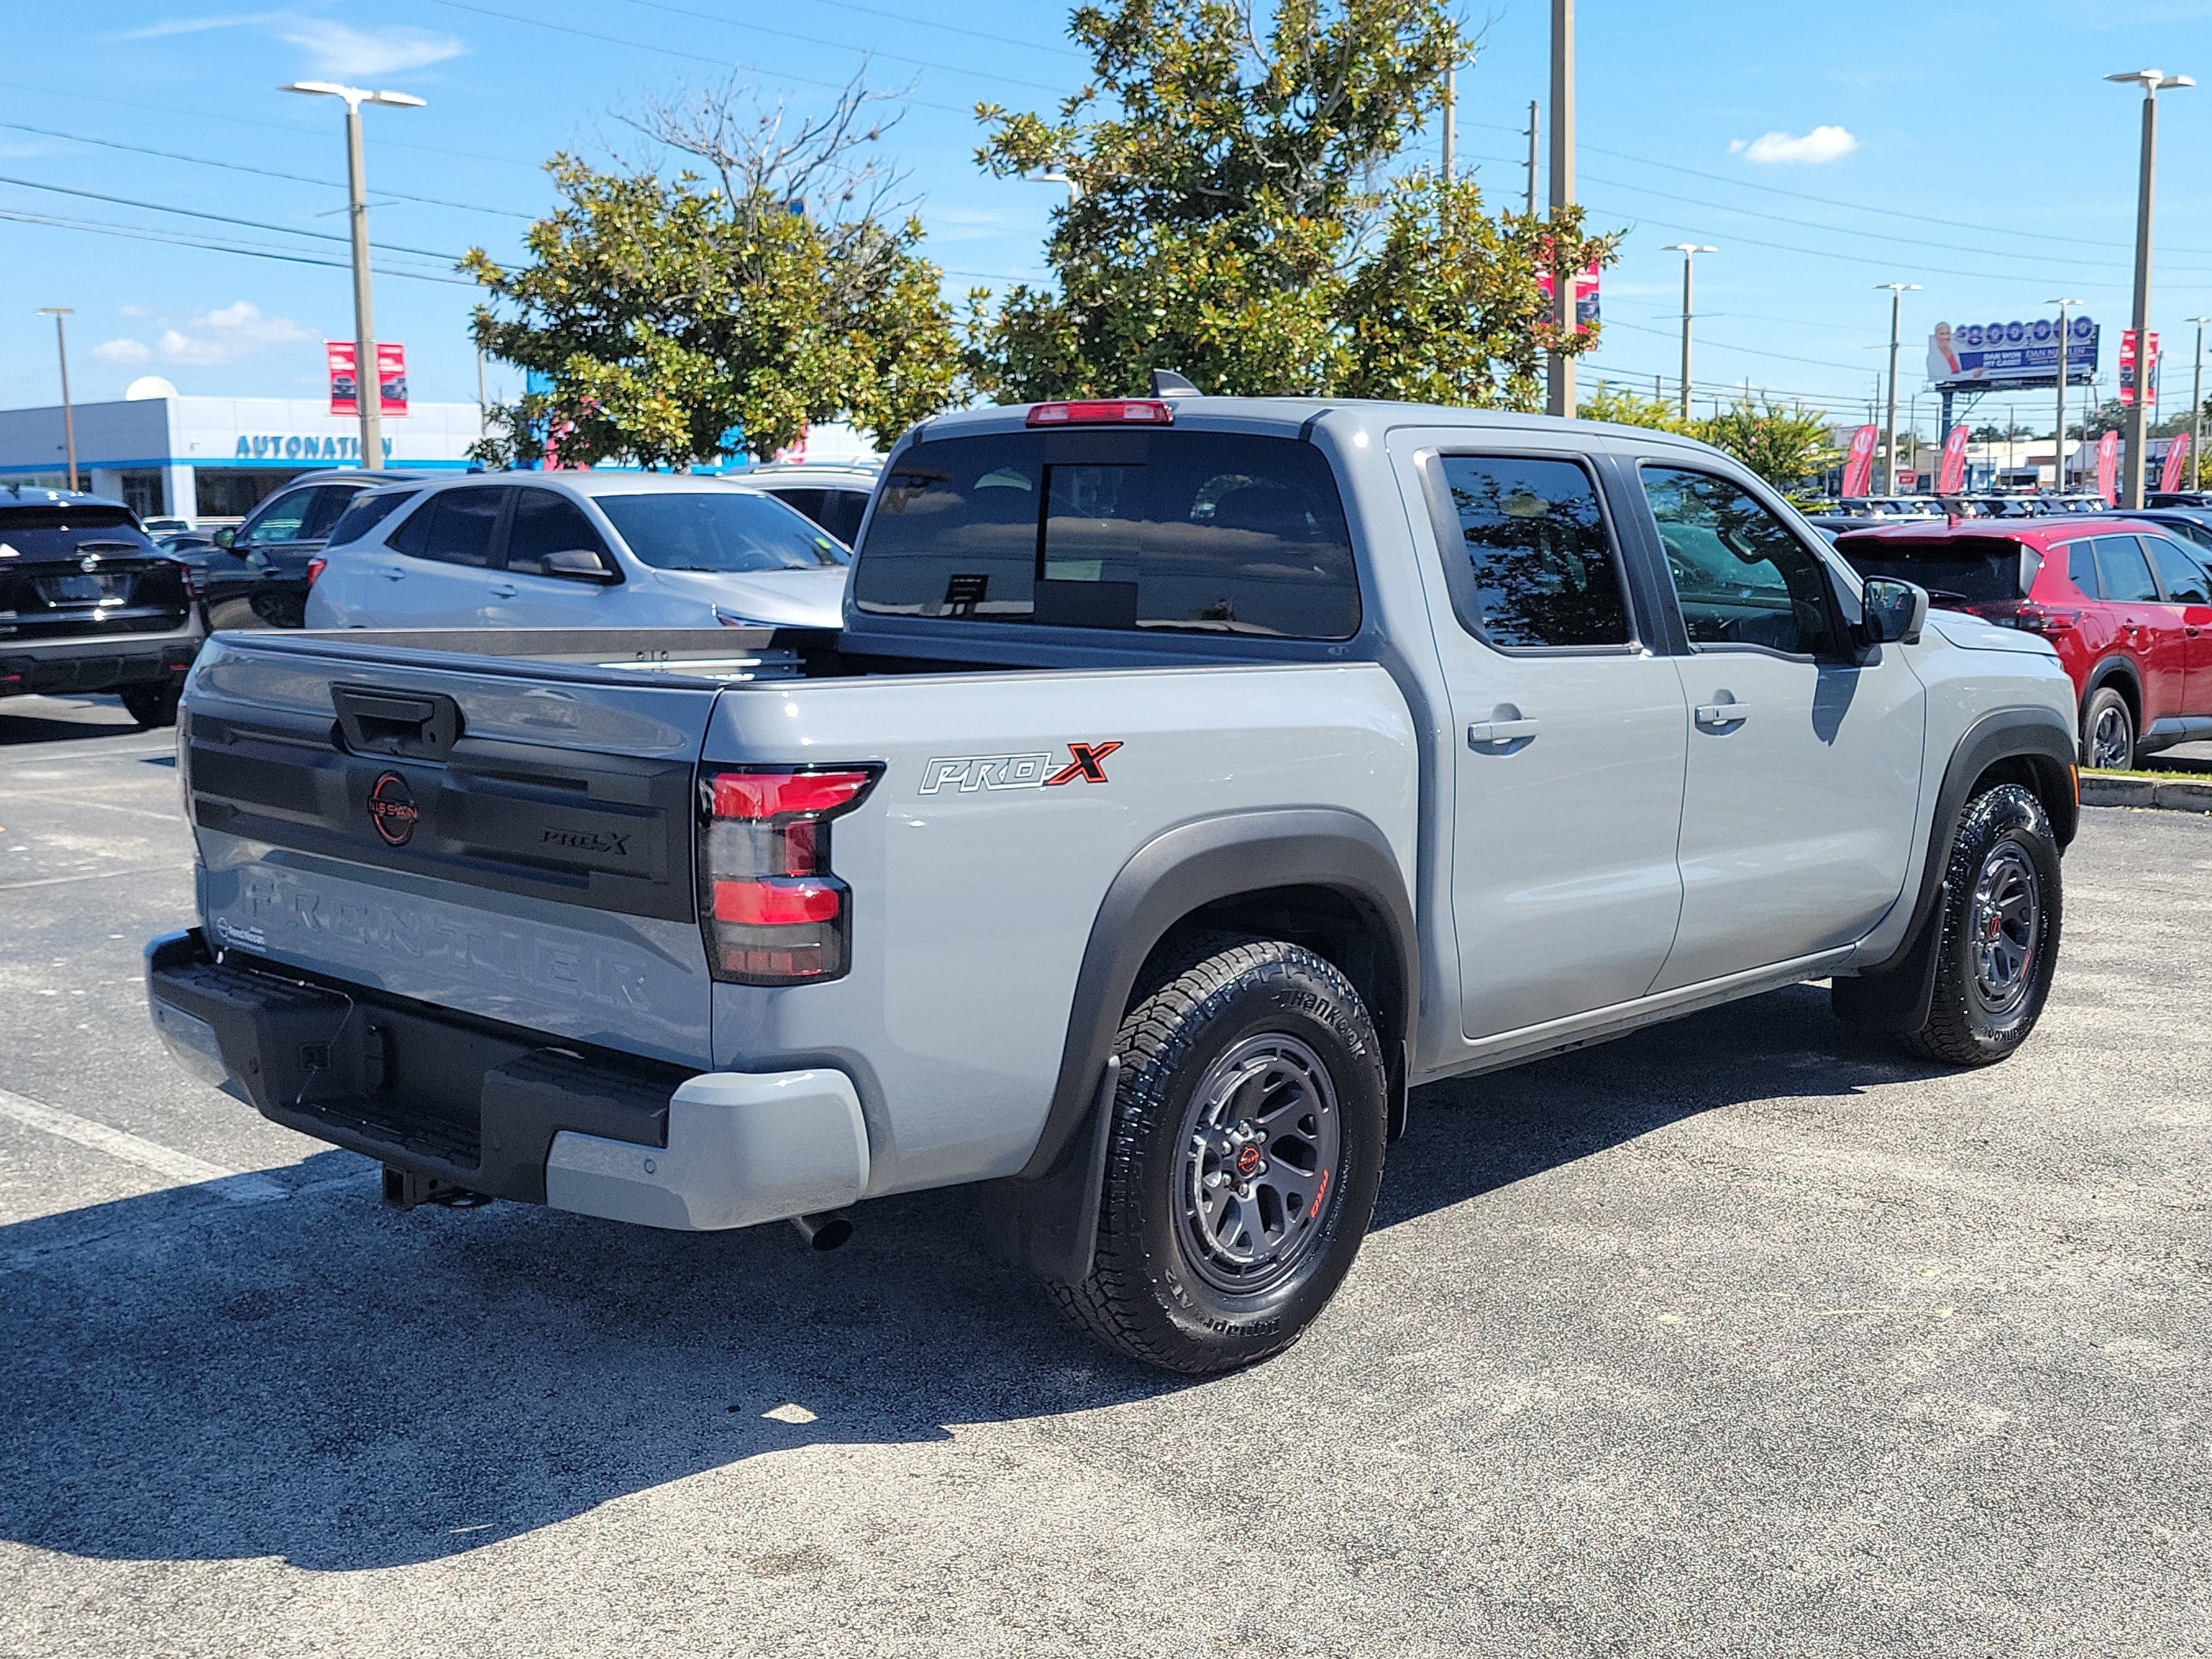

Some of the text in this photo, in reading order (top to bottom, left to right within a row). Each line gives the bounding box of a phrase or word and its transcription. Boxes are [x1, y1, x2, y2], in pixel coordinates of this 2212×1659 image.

[236, 436, 392, 459] AUTONATIN
[369, 799, 418, 819] NISSAN
[240, 870, 651, 1013] FRONTIER
